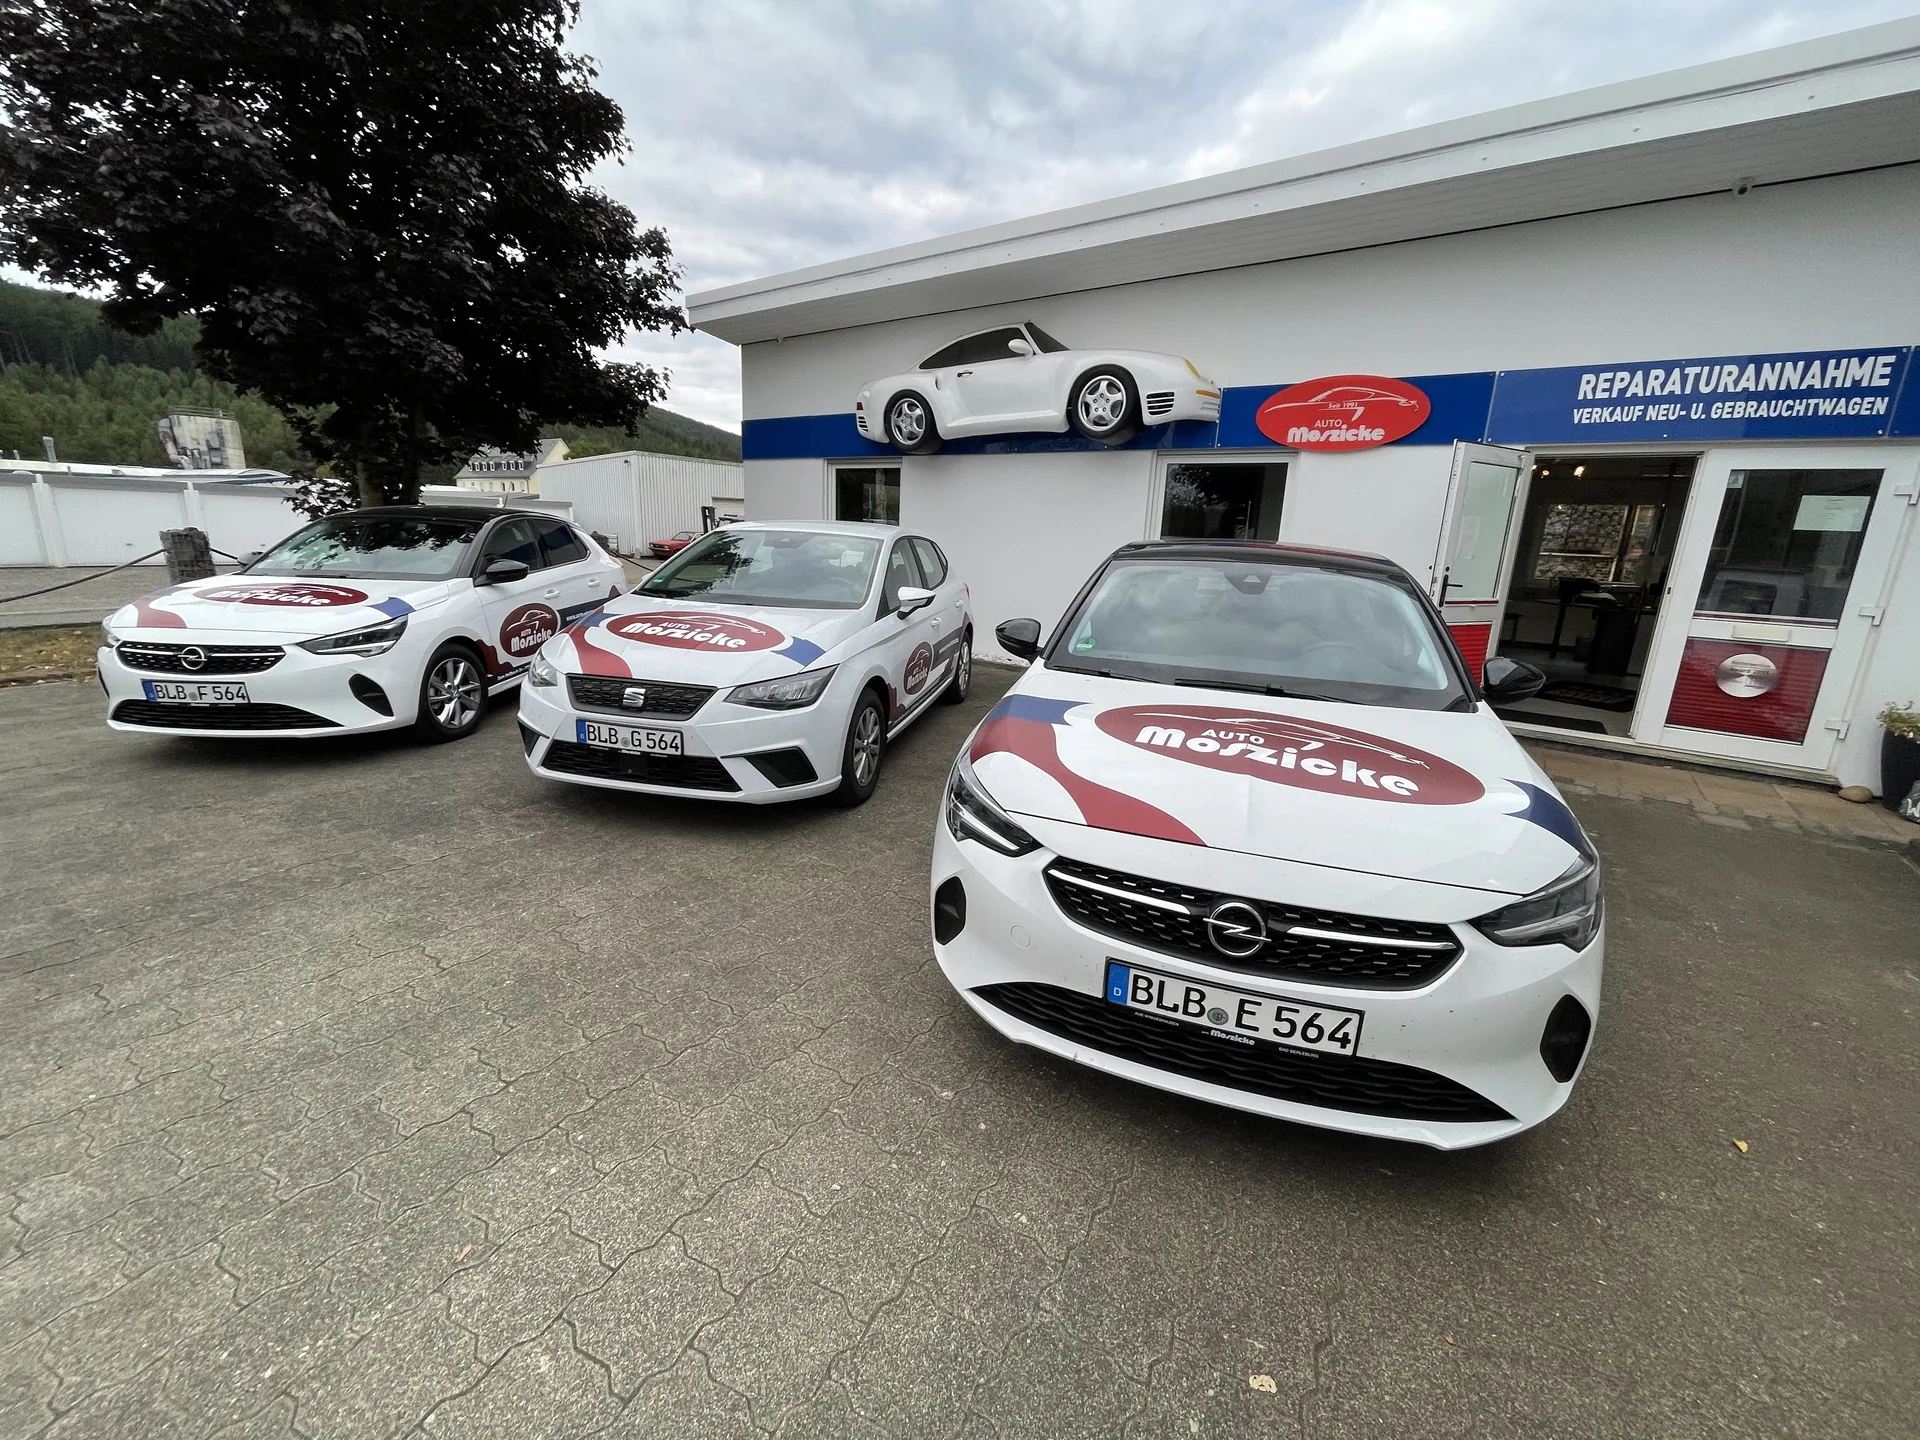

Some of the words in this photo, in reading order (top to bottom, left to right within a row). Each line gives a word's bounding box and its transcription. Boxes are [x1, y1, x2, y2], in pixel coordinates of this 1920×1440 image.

[1577, 355, 1897, 400] REPARATURANNAHME
[1573, 405, 1644, 424] VERKAUF
[1645, 403, 1686, 422] NEU-
[1690, 402, 1706, 420] U.
[1710, 397, 1889, 419] GEBRAUCHTWAGEN
[1287, 425, 1385, 443] Moszicke
[1314, 419, 1343, 428] AUTO
[619, 622, 747, 648] Moszicke
[659, 622, 691, 630] AUTO
[154, 684, 187, 699] BLB
[197, 686, 208, 700] F
[212, 686, 247, 701] 564
[586, 724, 619, 745] BLB
[631, 730, 642, 748] G
[646, 732, 680, 752] 564
[1200, 728, 1265, 745] AUTO
[1134, 726, 1420, 796] Moszicke
[1113, 986, 1122, 997] D
[1131, 973, 1208, 1018] BLB
[1235, 998, 1263, 1032] E
[1272, 1005, 1354, 1049] 564
